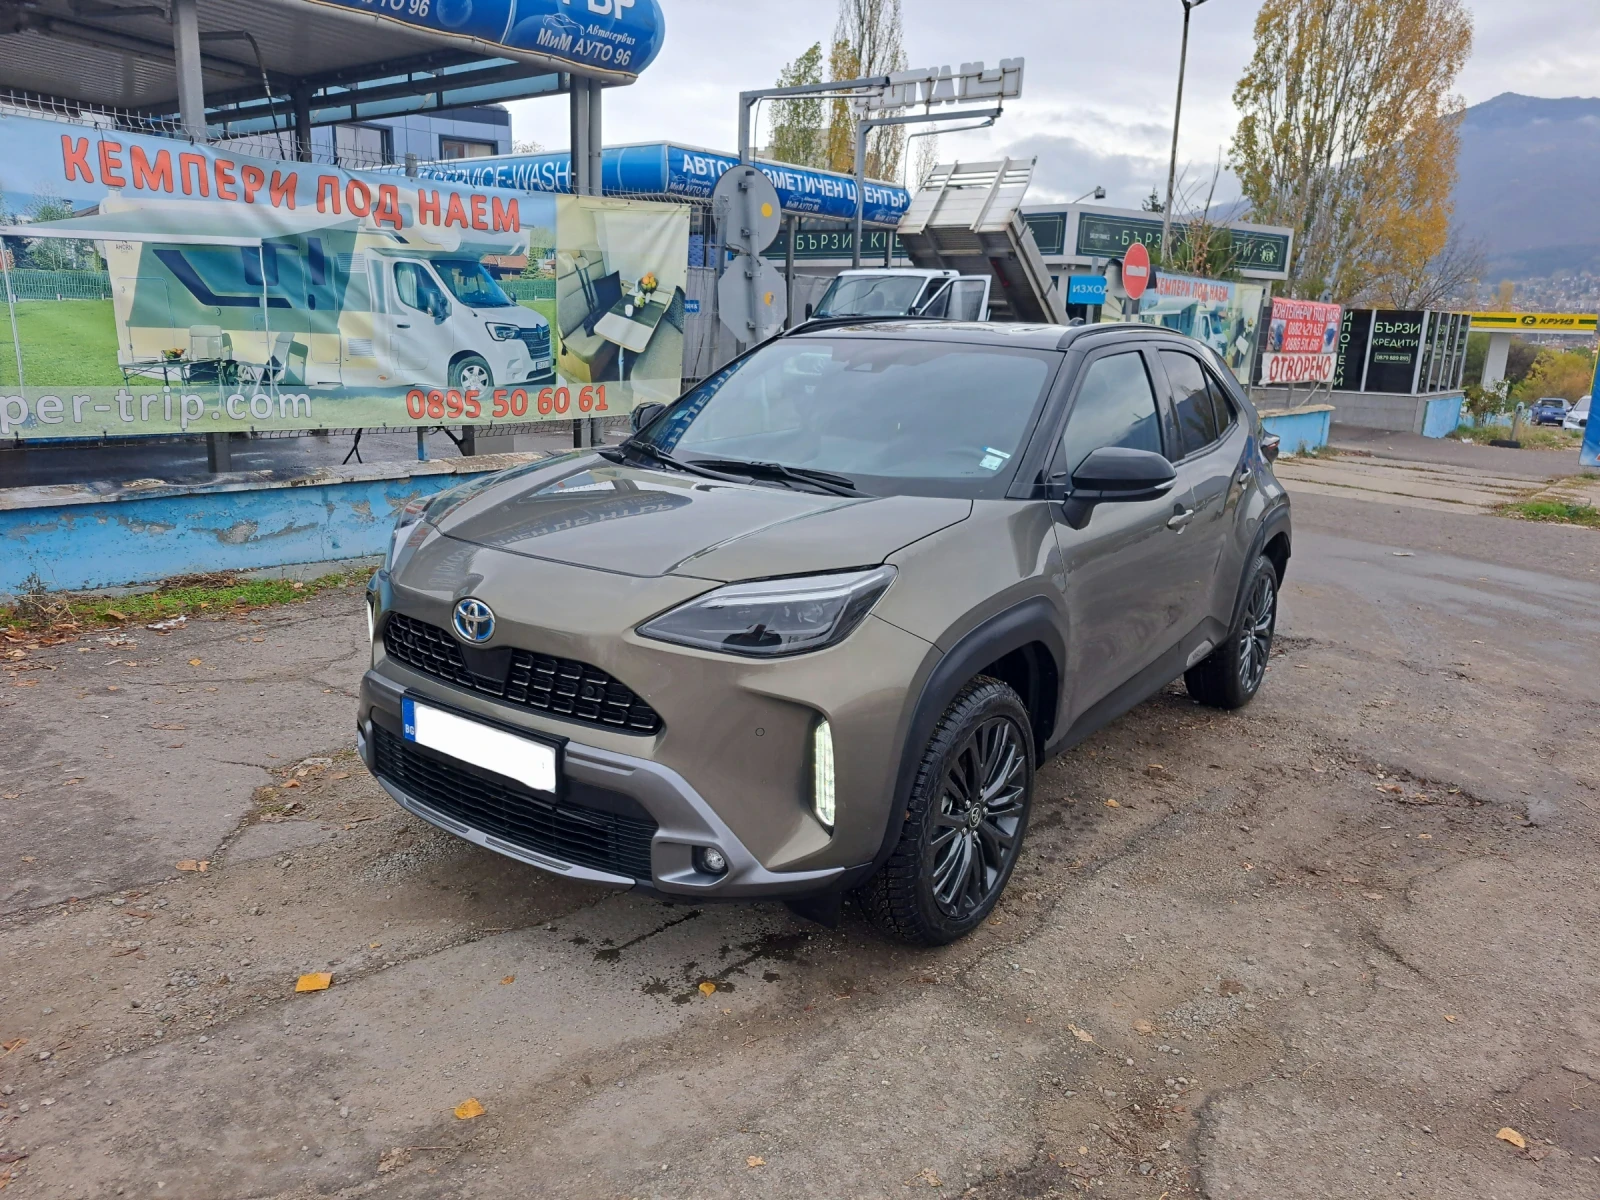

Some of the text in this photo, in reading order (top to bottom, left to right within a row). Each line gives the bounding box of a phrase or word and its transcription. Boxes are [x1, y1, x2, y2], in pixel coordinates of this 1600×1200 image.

[409, 0, 430, 17] 96
[586, 24, 635, 46] Автосервиз
[536, 27, 632, 66] МиМ АУТО 96
[60, 134, 520, 233] КЕМПЕРИ ПОД НАЕМ
[683, 154, 843, 199] АВТОЗМЕТИЧЕН
[796, 233, 852, 250] БЪРЗИ
[1121, 230, 1162, 248] БЪРЗ
[1154, 277, 1191, 297] КЕМПЕРИ
[1374, 321, 1421, 335] БЪРЗИ
[1372, 338, 1419, 348] КРЕДИТИ
[1269, 355, 1332, 382] ОТВОРЕНО
[0, 385, 313, 434] per-trip.com
[406, 384, 609, 419] 0895 50 60 61
[405, 724, 415, 735] BG
